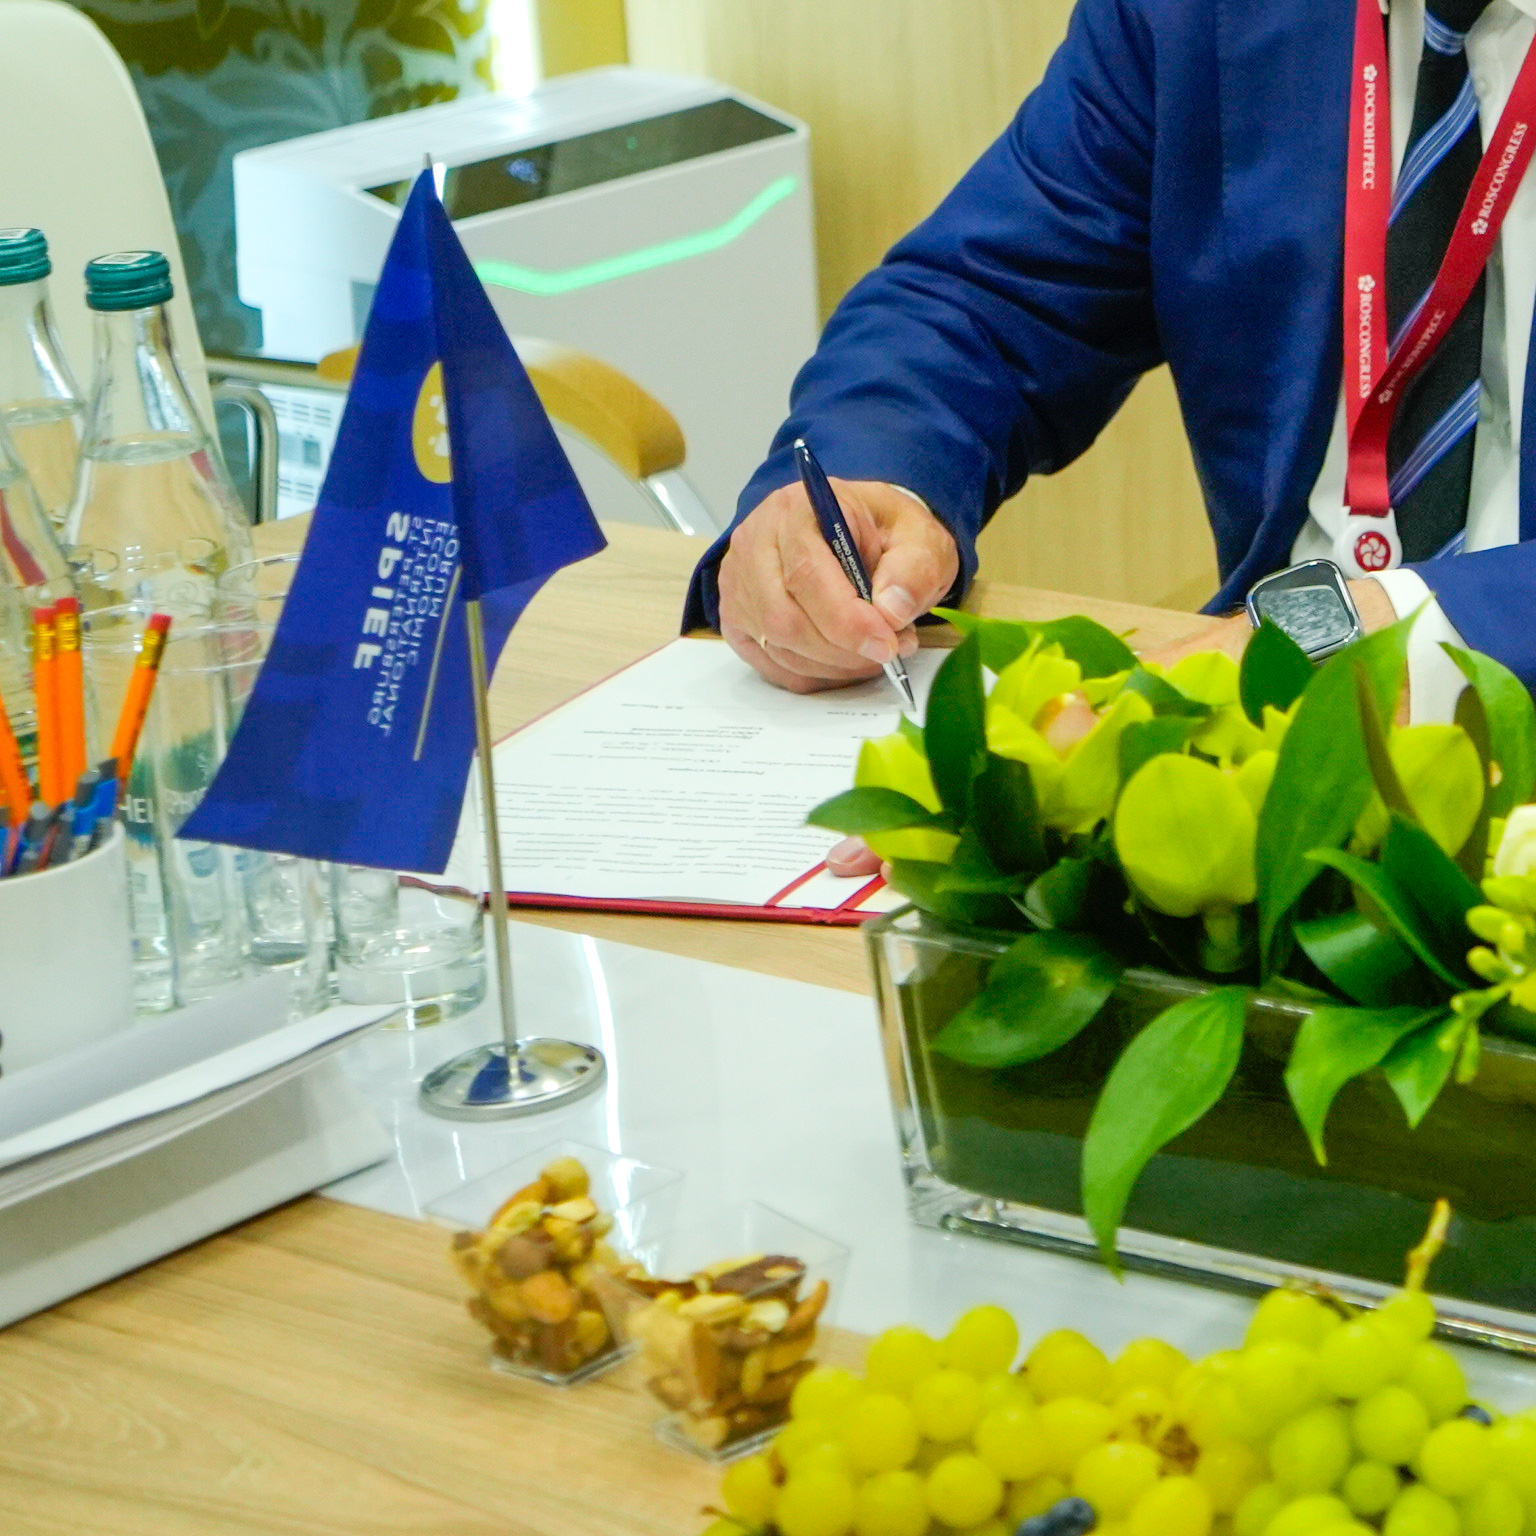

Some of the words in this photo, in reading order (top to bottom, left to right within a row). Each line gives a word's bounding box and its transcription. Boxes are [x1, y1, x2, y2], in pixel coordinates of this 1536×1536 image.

[1362, 83, 1376, 191] РОСКОНГРЕСС
[1478, 122, 1529, 218] ROSCONGRESS
[1358, 293, 1373, 398] ROSCONGRESS
